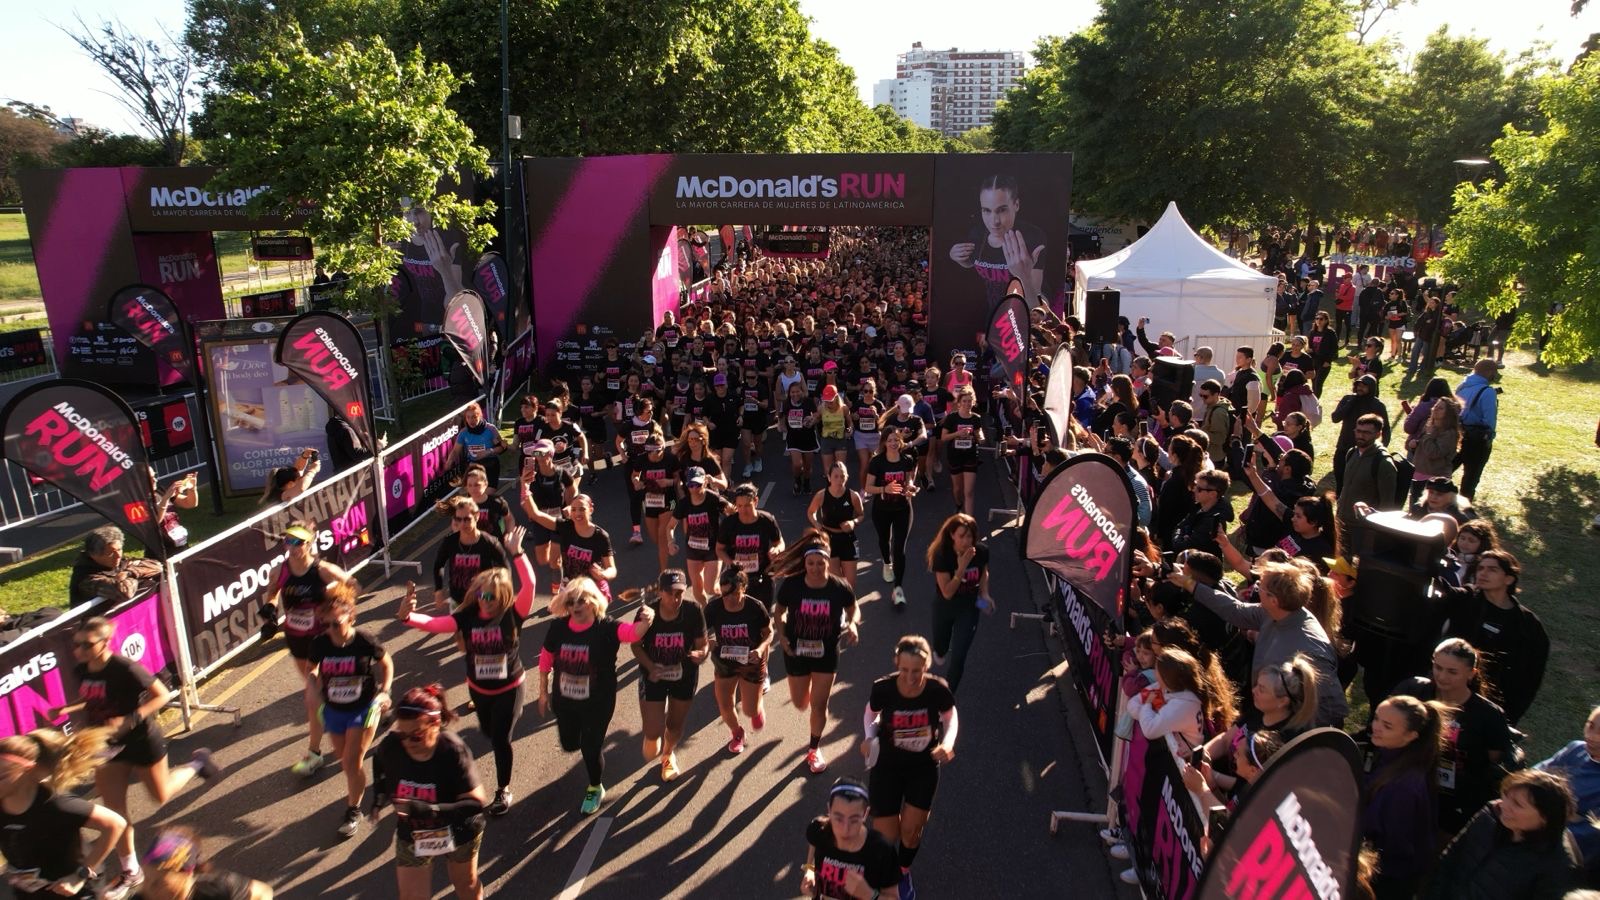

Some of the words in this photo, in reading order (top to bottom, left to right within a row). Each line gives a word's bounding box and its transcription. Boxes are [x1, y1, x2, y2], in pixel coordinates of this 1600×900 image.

[676, 175, 838, 198] McDonald's
[840, 173, 905, 199] RUN
[676, 201, 687, 209] LA
[689, 201, 719, 209] MAYOR
[720, 201, 760, 209] CARRERA
[762, 201, 774, 209] DE
[776, 201, 817, 209] MUJERES
[819, 201, 831, 209] DE
[833, 201, 905, 209] LATINOAMERICA
[152, 209, 161, 217] LA
[162, 209, 188, 217] MAYOR
[189, 209, 222, 217] CARRERA
[1330, 254, 1418, 268] McDonald's
[159, 261, 202, 284] RUN
[975, 265, 1009, 282] RUN
[242, 361, 267, 370] Dove
[253, 370, 269, 378] deo
[54, 401, 134, 470] McDonald's
[24, 408, 125, 492] RUN
[244, 447, 296, 460] CONTROL
[232, 460, 262, 470] OLOR
[266, 456, 292, 466] PARA
[735, 537, 760, 548] RUN
[566, 546, 593, 562] RUN
[203, 529, 334, 623] McDo's
[331, 500, 368, 545] RUN
[454, 556, 480, 568] RUN
[800, 602, 831, 616] RUN
[471, 628, 502, 642] RUN
[721, 628, 749, 639] RUN
[124, 640, 143, 658] 10K
[654, 636, 684, 649] RUN
[560, 648, 590, 662] RUN
[322, 660, 356, 676] RUN
[893, 714, 928, 728] RUN
[396, 784, 437, 801] RUN
